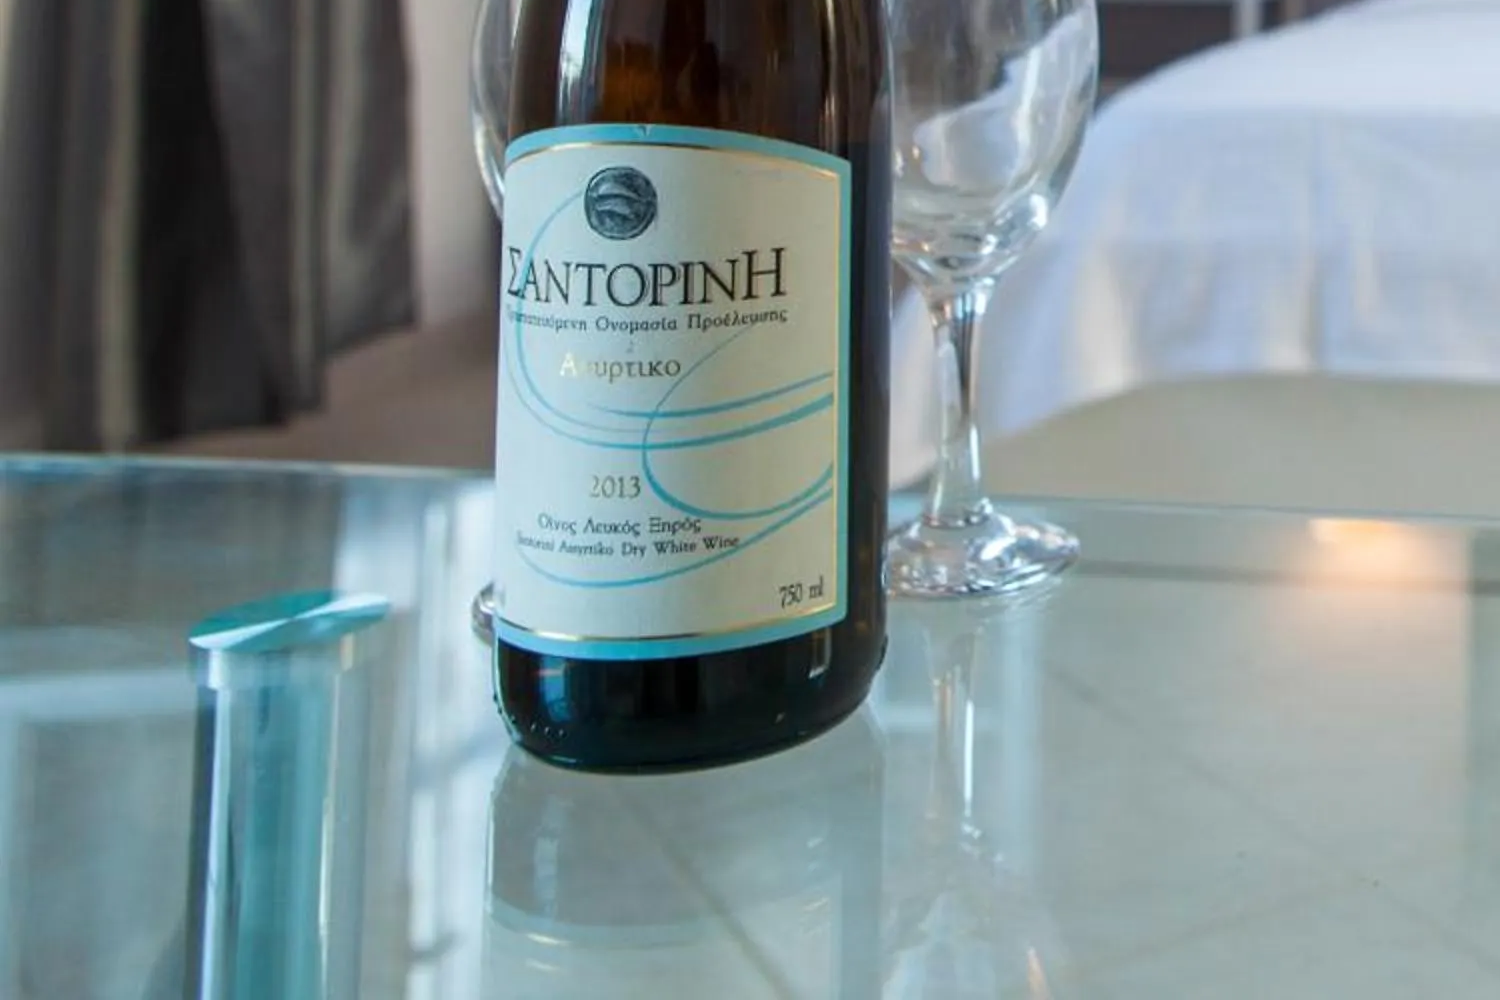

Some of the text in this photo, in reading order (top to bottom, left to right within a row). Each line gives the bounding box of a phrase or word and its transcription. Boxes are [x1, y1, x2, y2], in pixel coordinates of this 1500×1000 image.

[506, 246, 787, 307] ΣΑΝΤΟΡΙΝΗ
[595, 315, 679, 335] Ονομασία
[686, 308, 788, 333] Προέλευσης
[558, 351, 682, 385] Αυρτικο
[589, 474, 642, 499] 2013
[583, 516, 641, 537] Λευκός
[648, 515, 702, 536] Ξηρός
[621, 541, 647, 557] Dry
[654, 537, 697, 555] White
[702, 534, 740, 551] Wine
[779, 574, 824, 609] 750 ml
